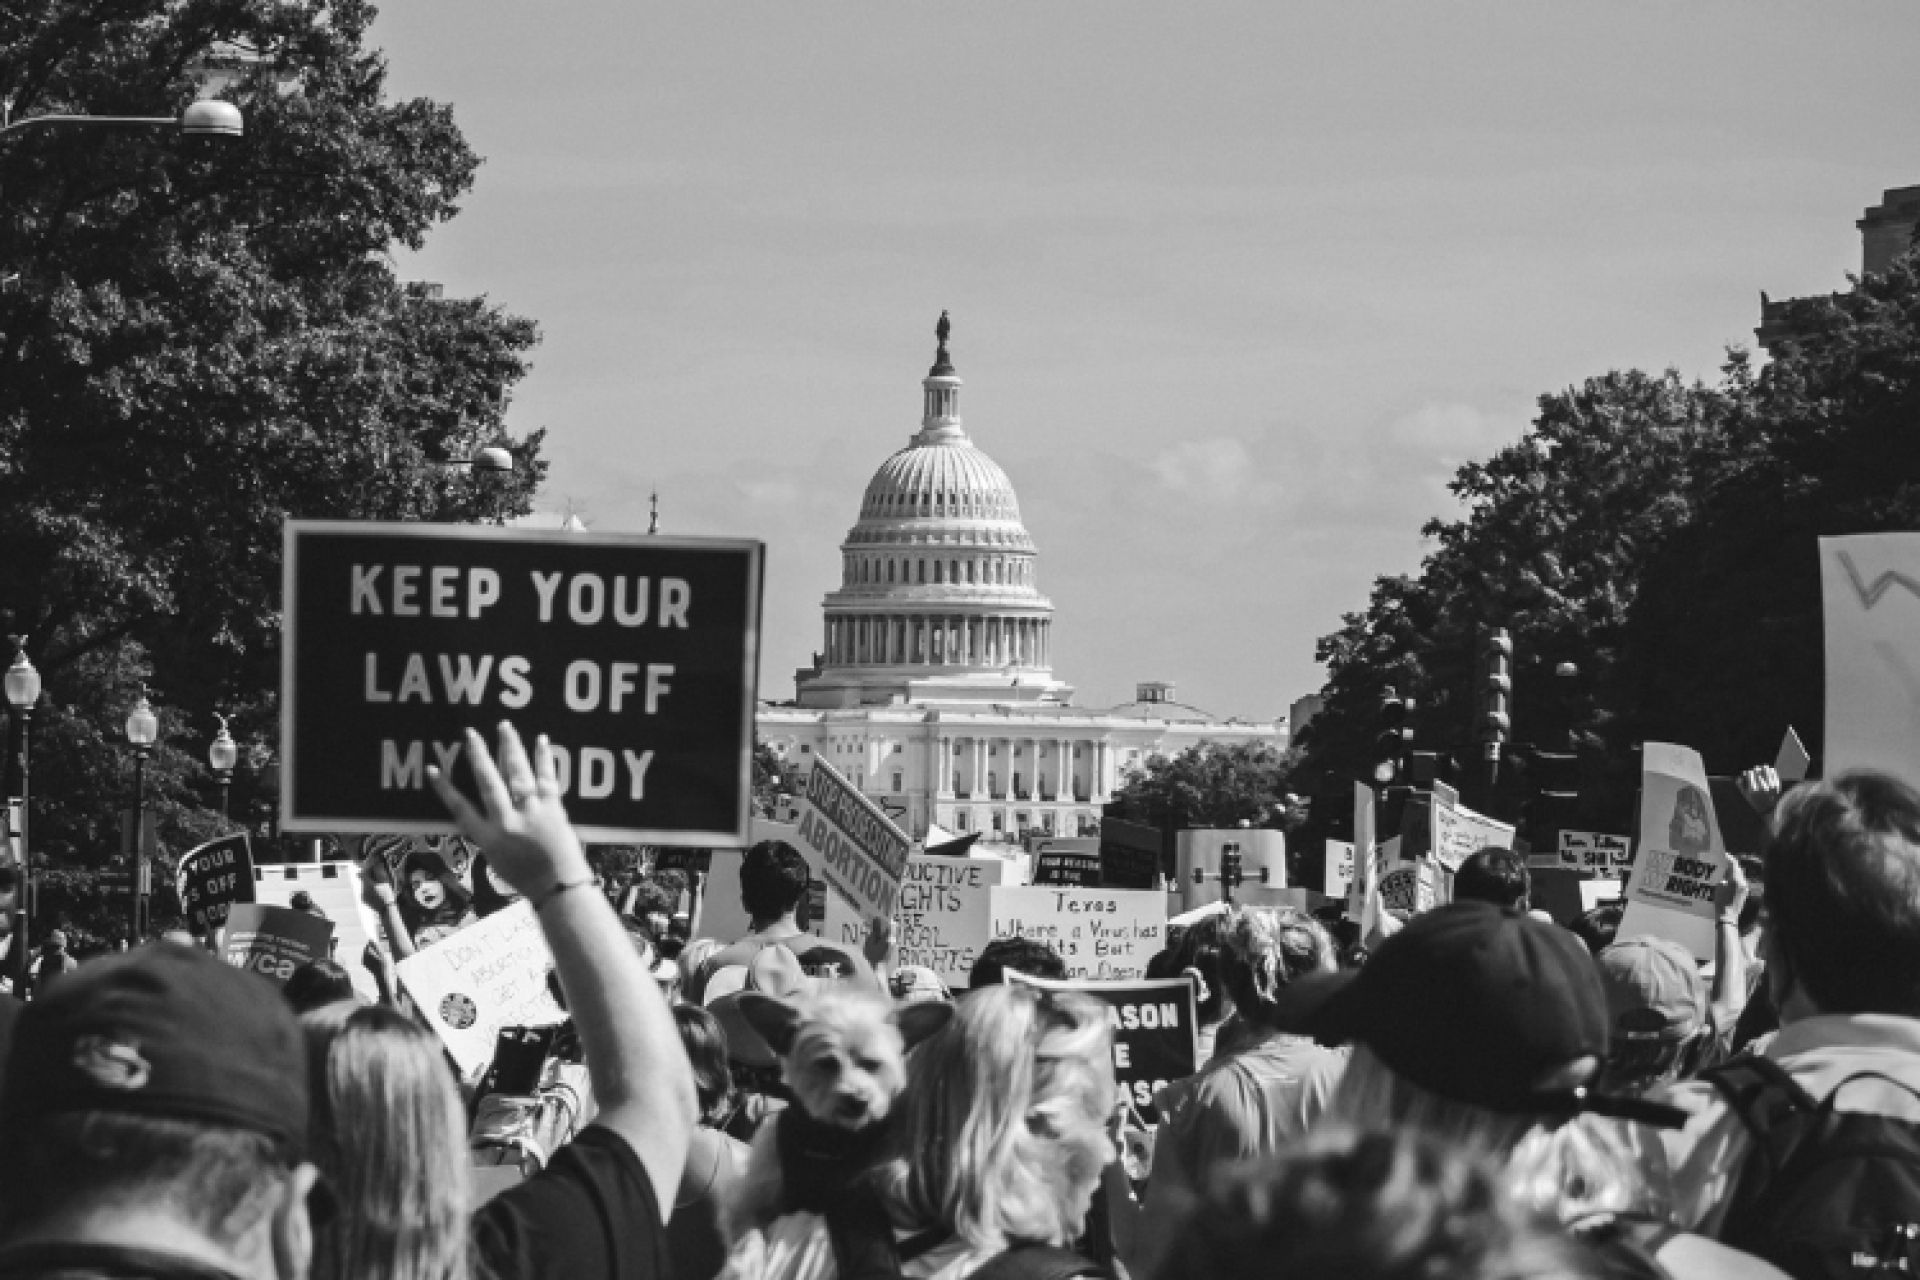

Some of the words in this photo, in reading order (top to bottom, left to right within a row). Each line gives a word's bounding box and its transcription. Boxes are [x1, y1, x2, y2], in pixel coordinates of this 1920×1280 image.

[349, 564, 501, 620] KEEP
[530, 570, 692, 630] YOUR
[364, 651, 534, 710] LAWS
[564, 659, 676, 715] OFF
[380, 739, 462, 790] MY
[547, 744, 656, 802] ODY
[799, 808, 896, 917] ABORTION
[1672, 855, 1718, 882] BODY
[995, 918, 1058, 938] Where
